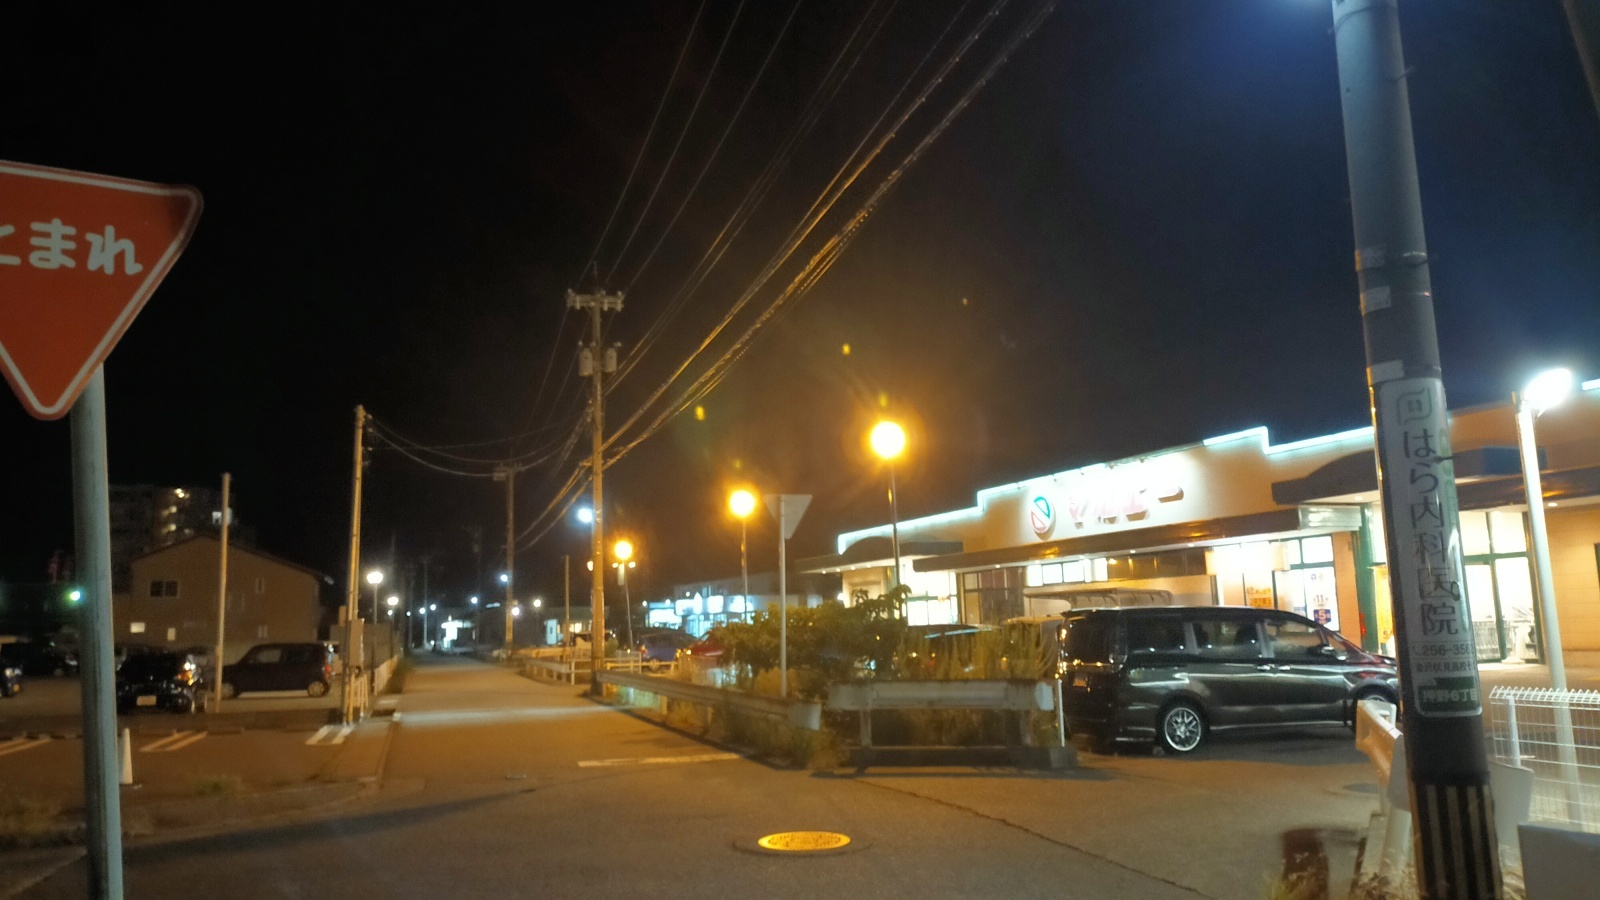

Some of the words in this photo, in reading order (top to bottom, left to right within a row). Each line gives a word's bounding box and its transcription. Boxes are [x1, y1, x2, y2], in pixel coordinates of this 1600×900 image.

[1403, 427, 1459, 635] はら内科医院
